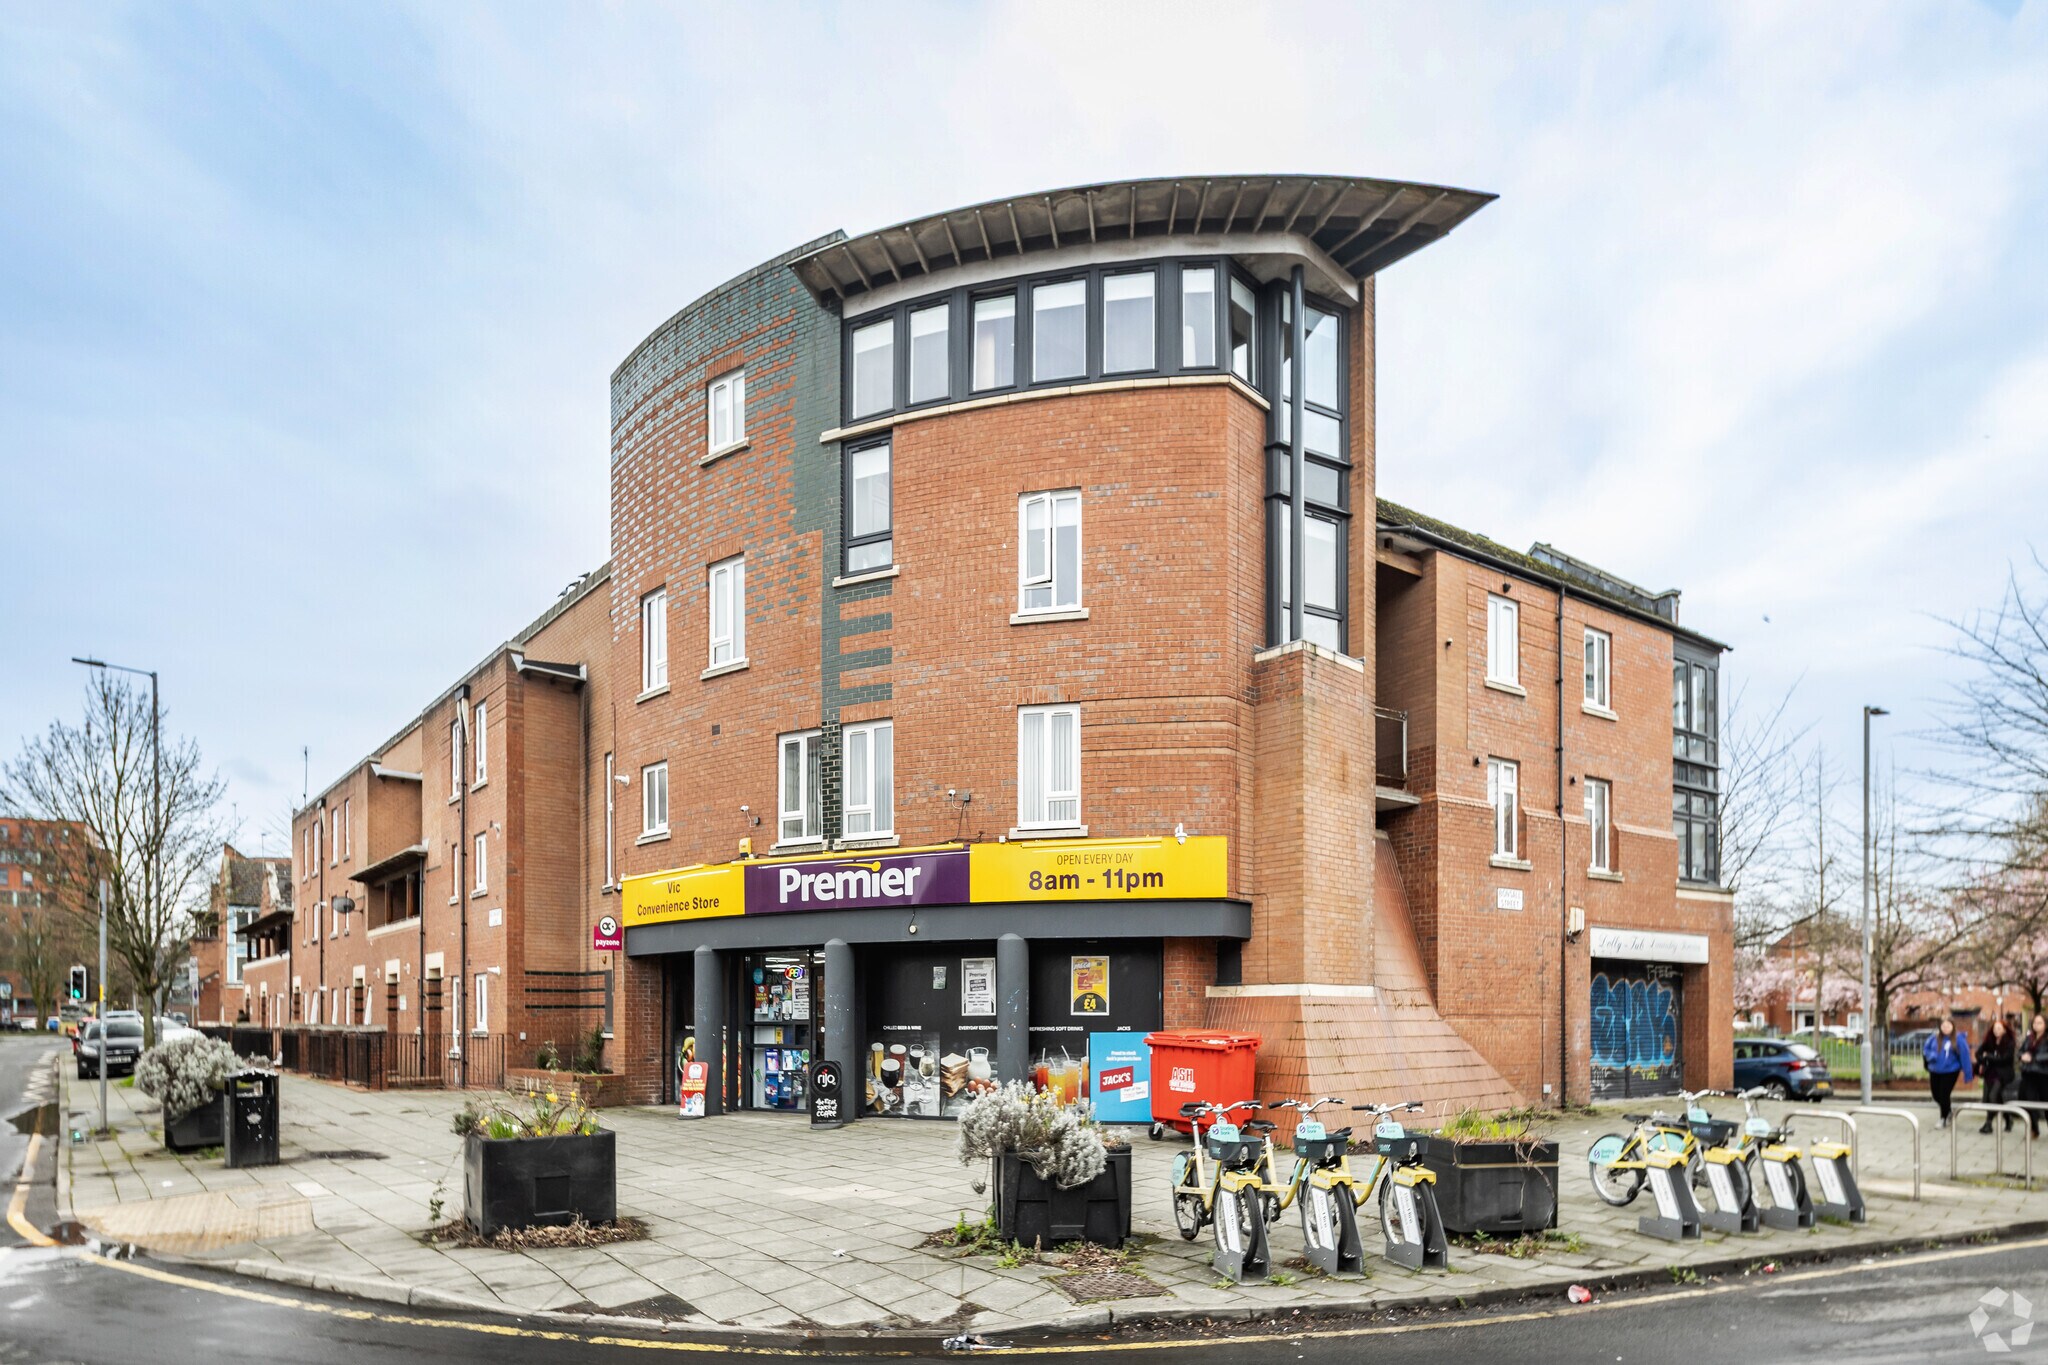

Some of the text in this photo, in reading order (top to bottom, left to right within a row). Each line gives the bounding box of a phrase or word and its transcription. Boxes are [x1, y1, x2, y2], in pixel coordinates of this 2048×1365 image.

[1057, 852, 1134, 866] OPEN EVERY DAY
[779, 862, 922, 904] Premier
[1028, 870, 1080, 891] 8am
[1102, 869, 1164, 893] 11pm
[667, 882, 681, 895] Vic
[637, 896, 720, 917] Convenience Store
[595, 939, 620, 948] payzone
[1083, 998, 1096, 1010] £4
[817, 1068, 836, 1087] rijo
[1102, 1072, 1131, 1085] JACK'S
[1171, 1067, 1194, 1081] ASH
